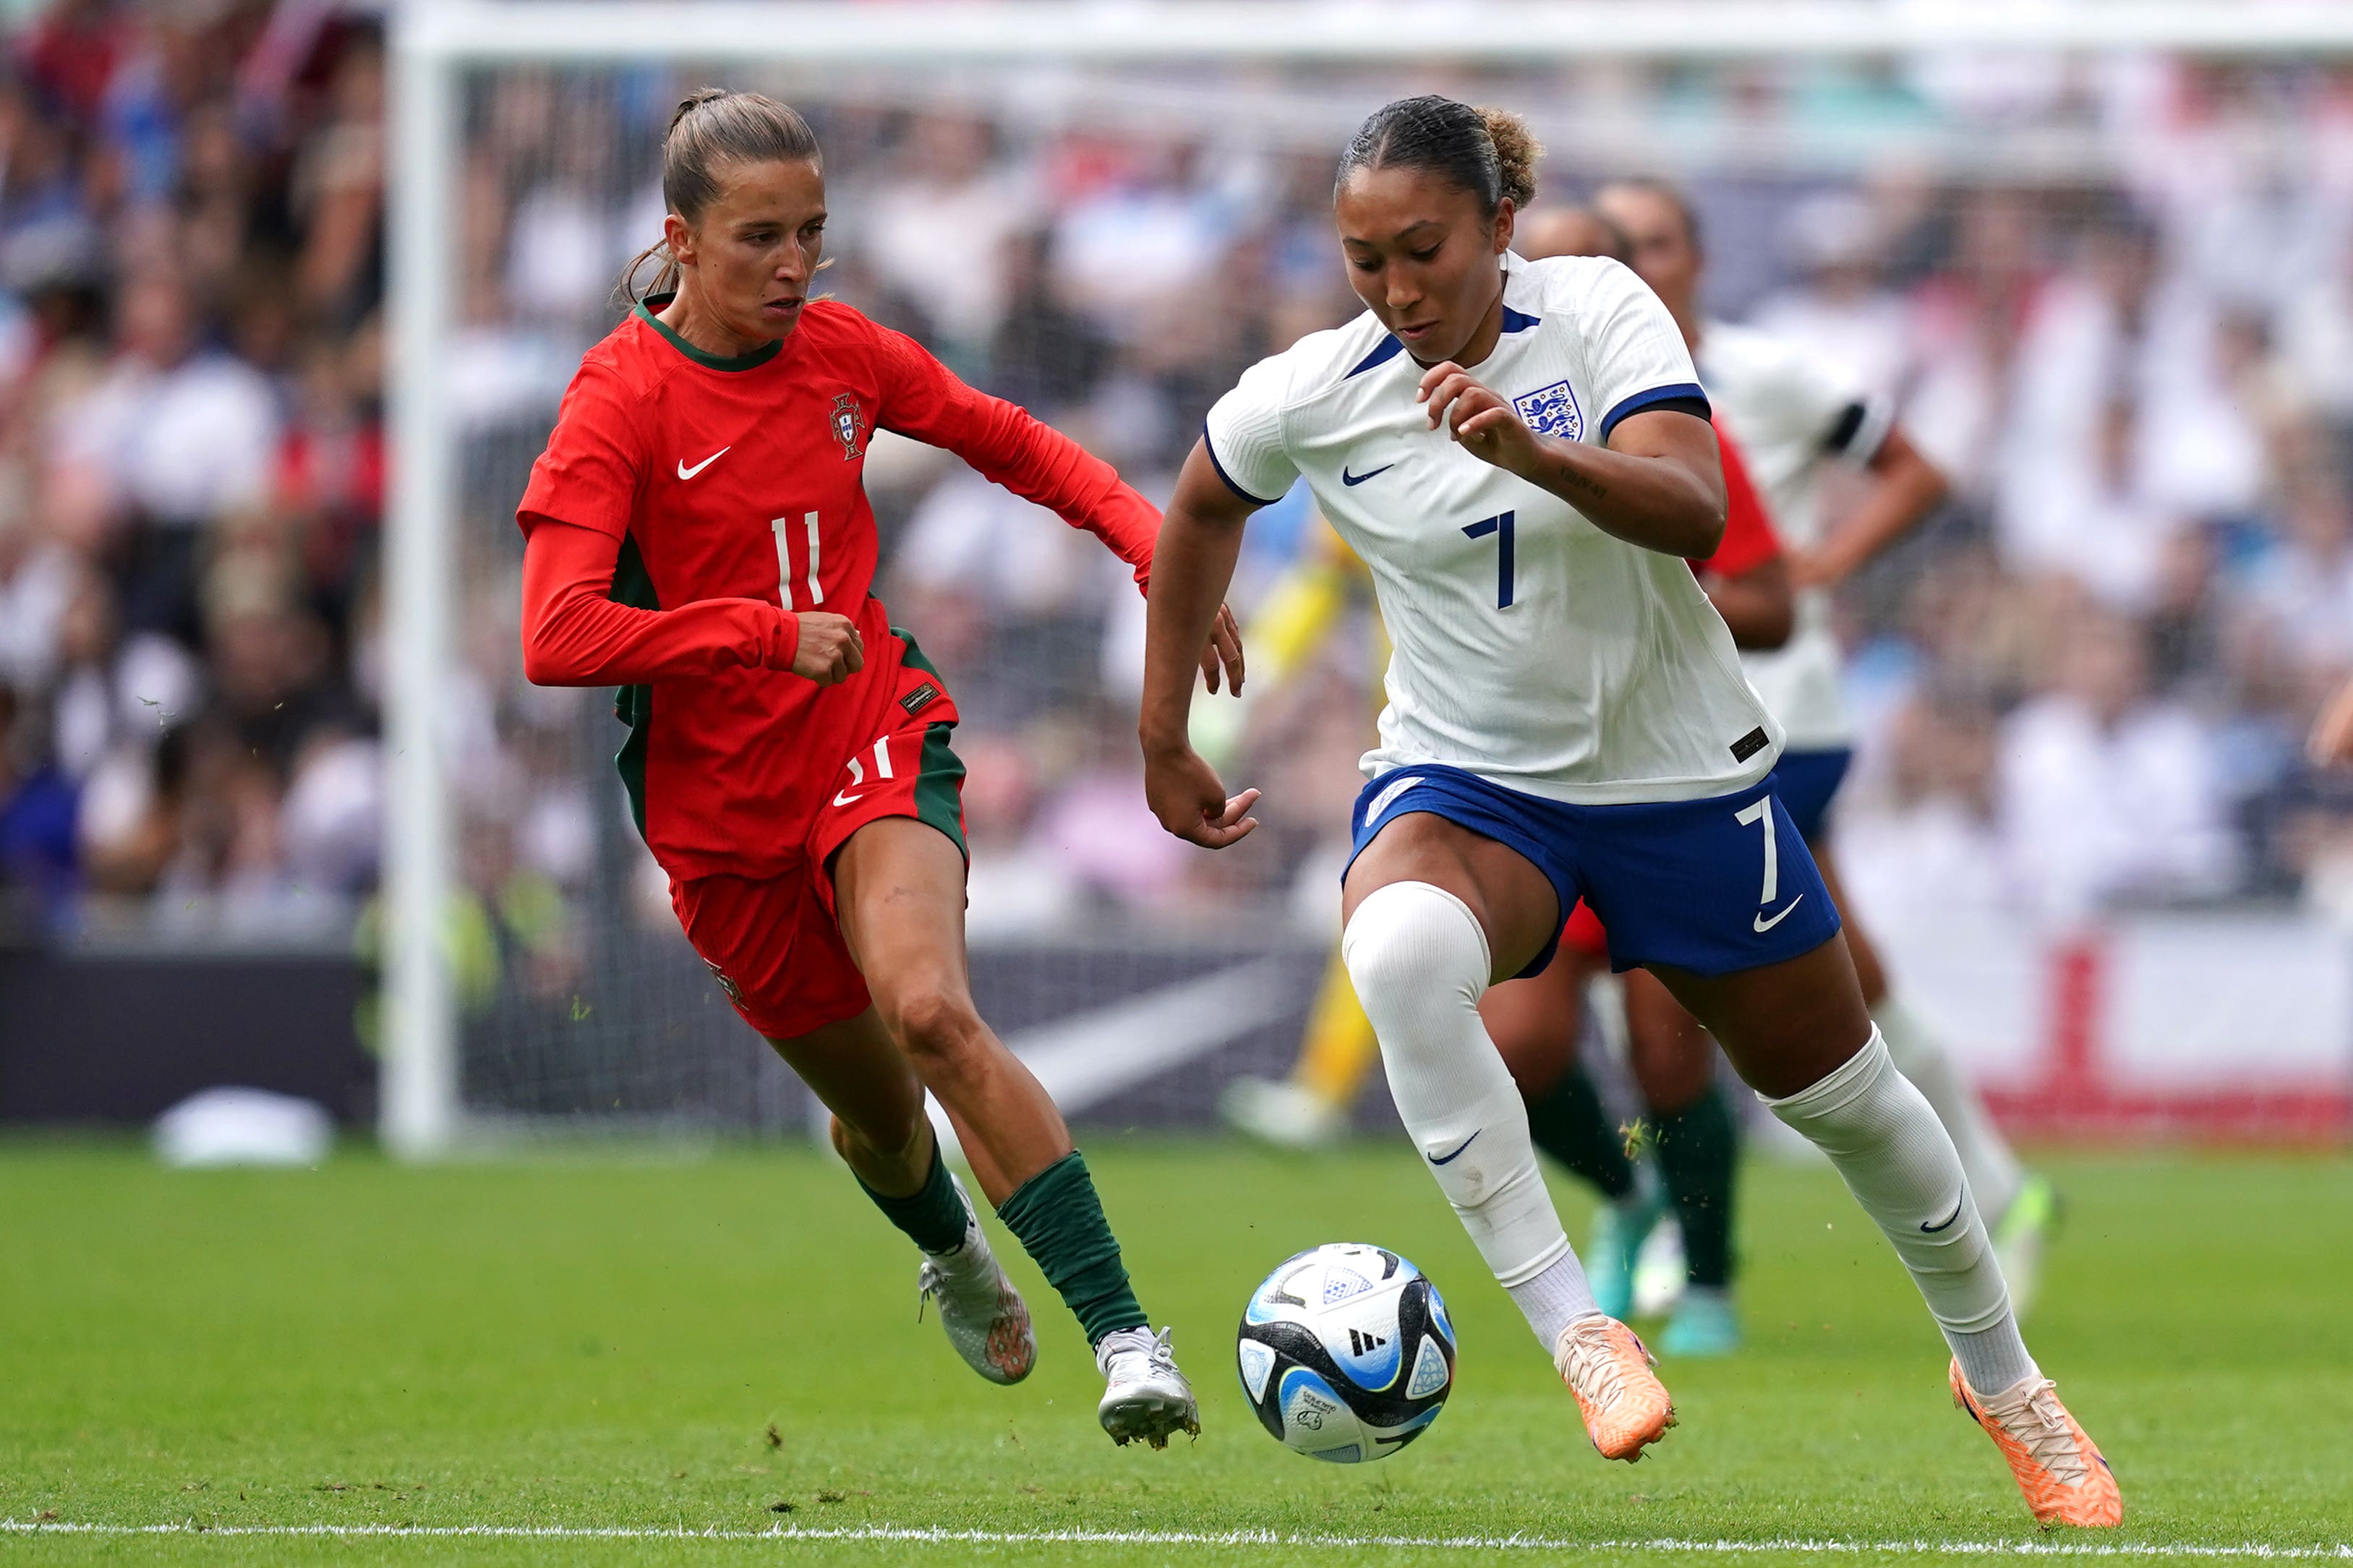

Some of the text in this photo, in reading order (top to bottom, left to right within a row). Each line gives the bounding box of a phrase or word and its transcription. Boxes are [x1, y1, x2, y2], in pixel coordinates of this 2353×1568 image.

[772, 510, 824, 610] 11
[1461, 510, 1515, 610] 7
[1734, 794, 1777, 904] 7
